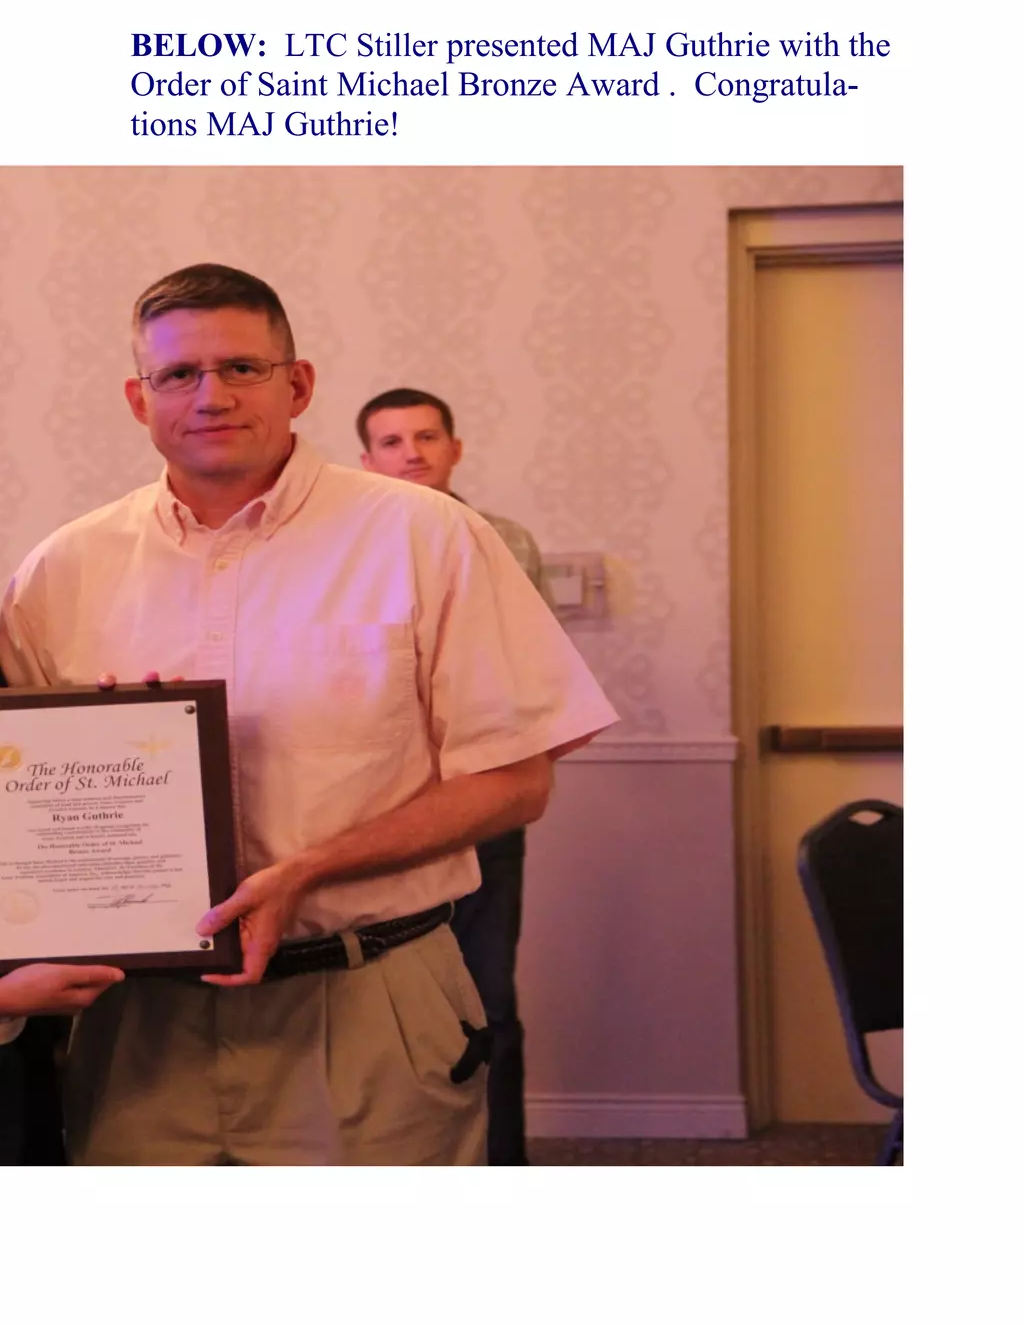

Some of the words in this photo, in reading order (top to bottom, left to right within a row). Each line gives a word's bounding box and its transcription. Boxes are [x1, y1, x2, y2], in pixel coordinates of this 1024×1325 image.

[27, 761, 56, 777] The
[60, 757, 144, 775] Honorable
[5, 776, 51, 793] Order
[54, 775, 74, 795] of
[75, 776, 98, 791] St.
[104, 770, 172, 789] Michael
[52, 812, 80, 824] Ryan
[82, 810, 124, 821] Guthrie
